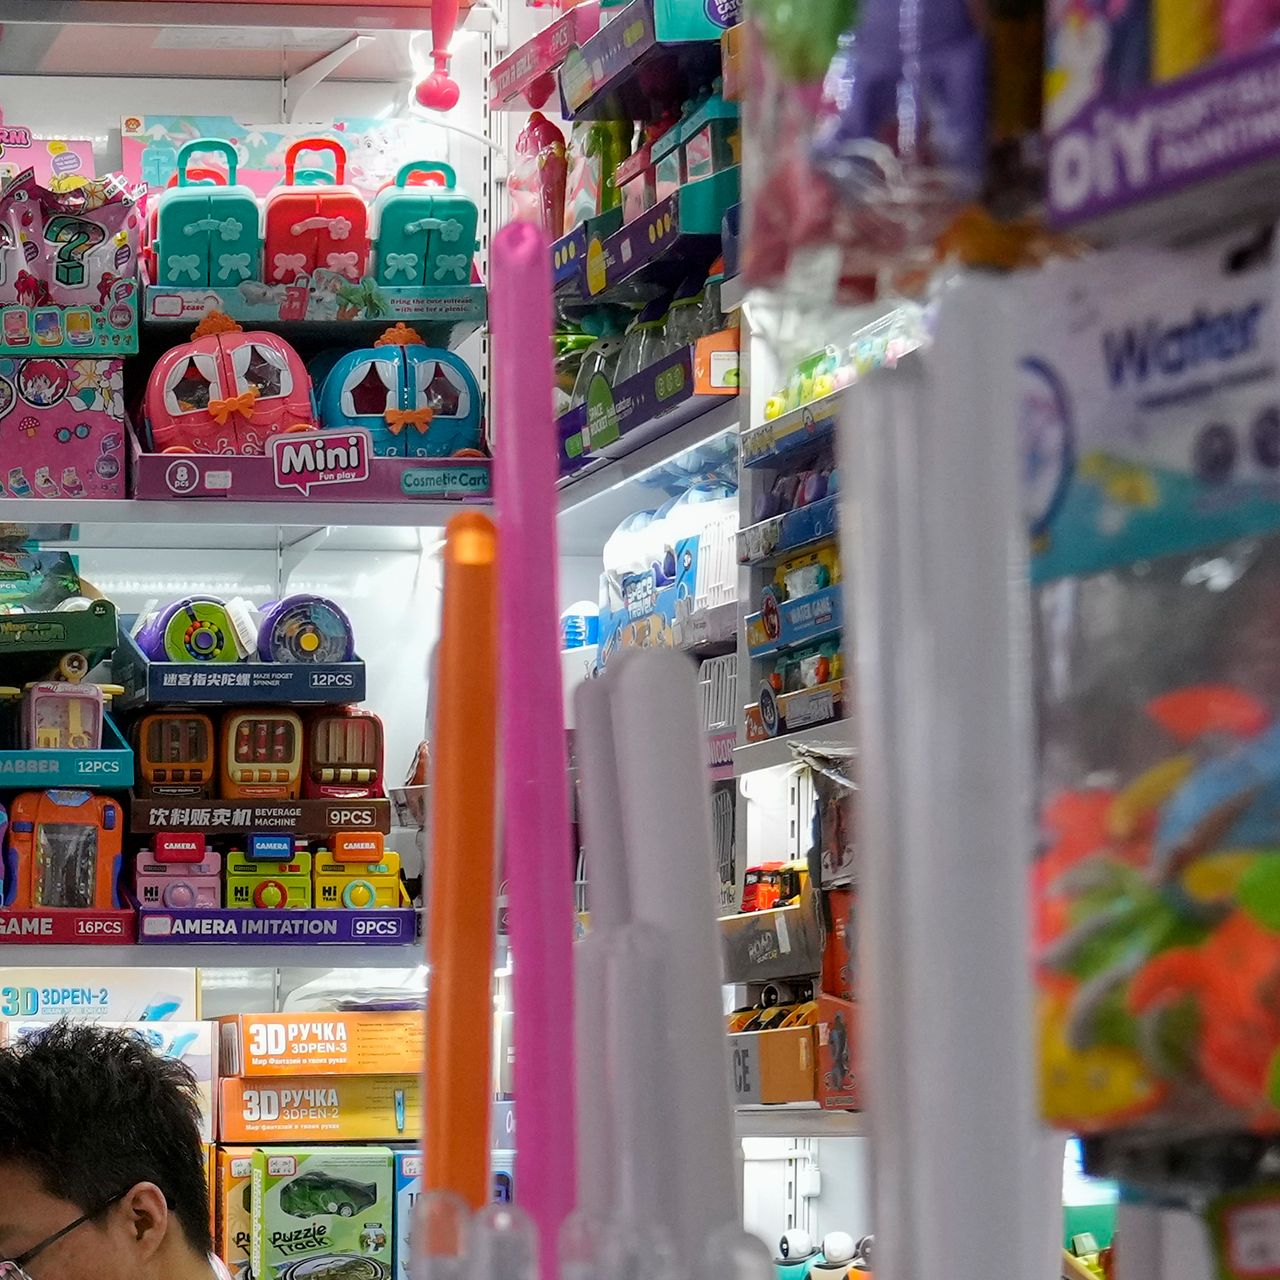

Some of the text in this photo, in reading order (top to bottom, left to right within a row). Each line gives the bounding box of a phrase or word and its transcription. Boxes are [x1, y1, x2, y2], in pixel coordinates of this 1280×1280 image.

[281, 437, 359, 474] Mini
[176, 466, 189, 481] 8
[319, 471, 356, 483] Fun play
[403, 472, 489, 488] Cosmetic Cart
[163, 673, 251, 687] 迷宫指尖陀螺
[312, 675, 352, 686] 12PCS
[78, 760, 120, 773] 12PCS
[149, 808, 252, 826] 饮料贩卖机
[255, 809, 301, 817] BEVERAGE
[330, 811, 372, 824] 9PCS
[255, 818, 296, 826] MACHINE
[164, 842, 196, 850] CAMERA
[256, 842, 288, 850] CAMERA
[343, 842, 375, 850] CAMERA
[78, 921, 122, 933] 16PCS
[242, 919, 337, 934] IMITATION
[355, 920, 397, 934] 9PCS
[1, 987, 108, 1016] 3D 3DPEN-2
[287, 1022, 347, 1041] РУЧКА
[249, 1023, 286, 1056] 3D
[291, 1042, 348, 1054] 3DPEN-3
[281, 1088, 339, 1107] РУЧКА
[242, 1090, 280, 1121] 3D
[283, 1108, 339, 1120] 3DPEN-2
[273, 1236, 329, 1256] Track
